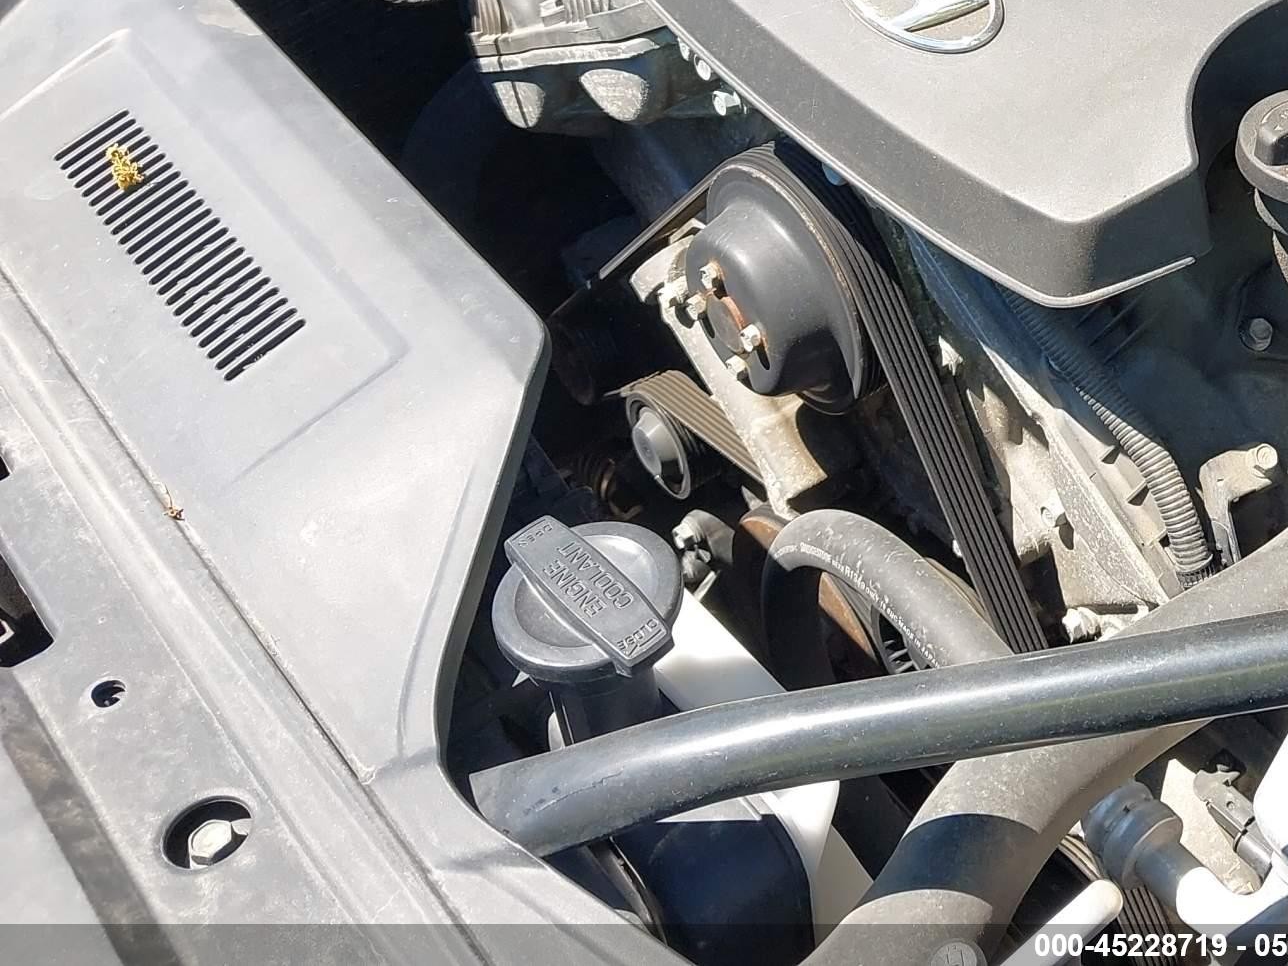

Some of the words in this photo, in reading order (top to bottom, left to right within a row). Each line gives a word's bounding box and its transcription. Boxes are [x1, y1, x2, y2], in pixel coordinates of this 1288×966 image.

[517, 522, 553, 548] OPEN
[542, 558, 607, 618] ENGINE
[557, 541, 634, 610] COOLANT
[617, 618, 659, 651] CLOSE
